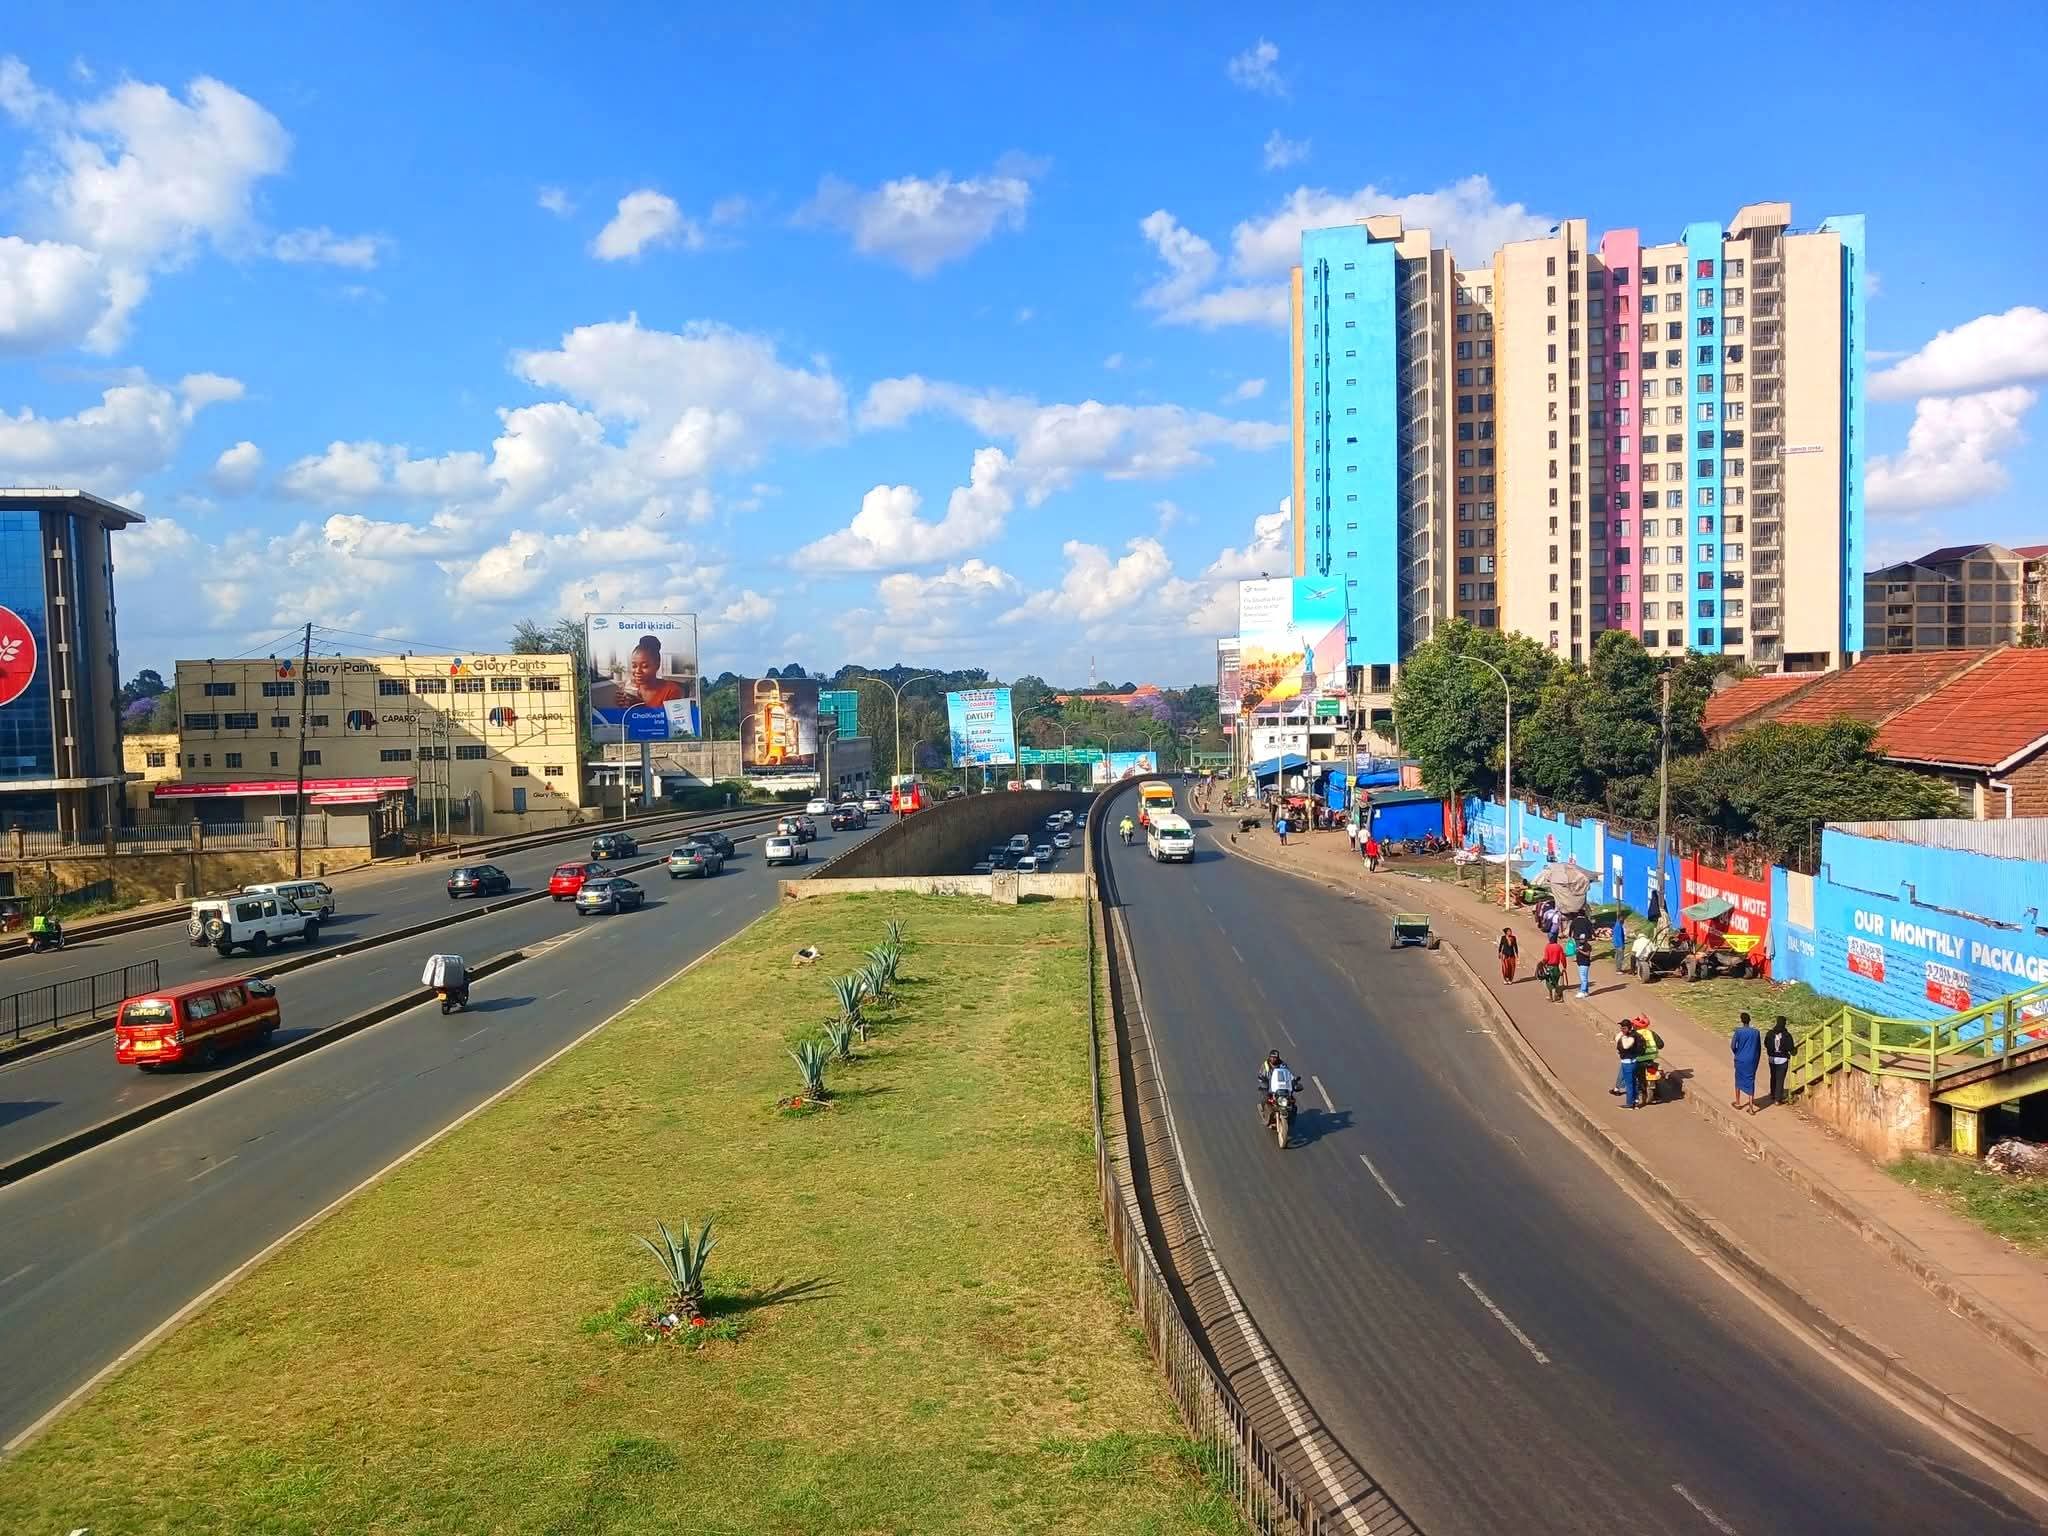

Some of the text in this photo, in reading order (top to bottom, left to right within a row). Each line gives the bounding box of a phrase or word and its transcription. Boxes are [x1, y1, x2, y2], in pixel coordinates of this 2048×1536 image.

[619, 621, 647, 630] Baridi
[304, 662, 380, 675] Glory Paints
[473, 659, 546, 673] Glory Paints
[381, 714, 420, 723] CAPARO
[526, 712, 563, 721] CAPAROL
[966, 711, 994, 720] DAYLIFF
[1741, 896, 1767, 918] WOTE
[1854, 909, 1885, 936] OUR
[1890, 919, 1965, 960] MONTHLY
